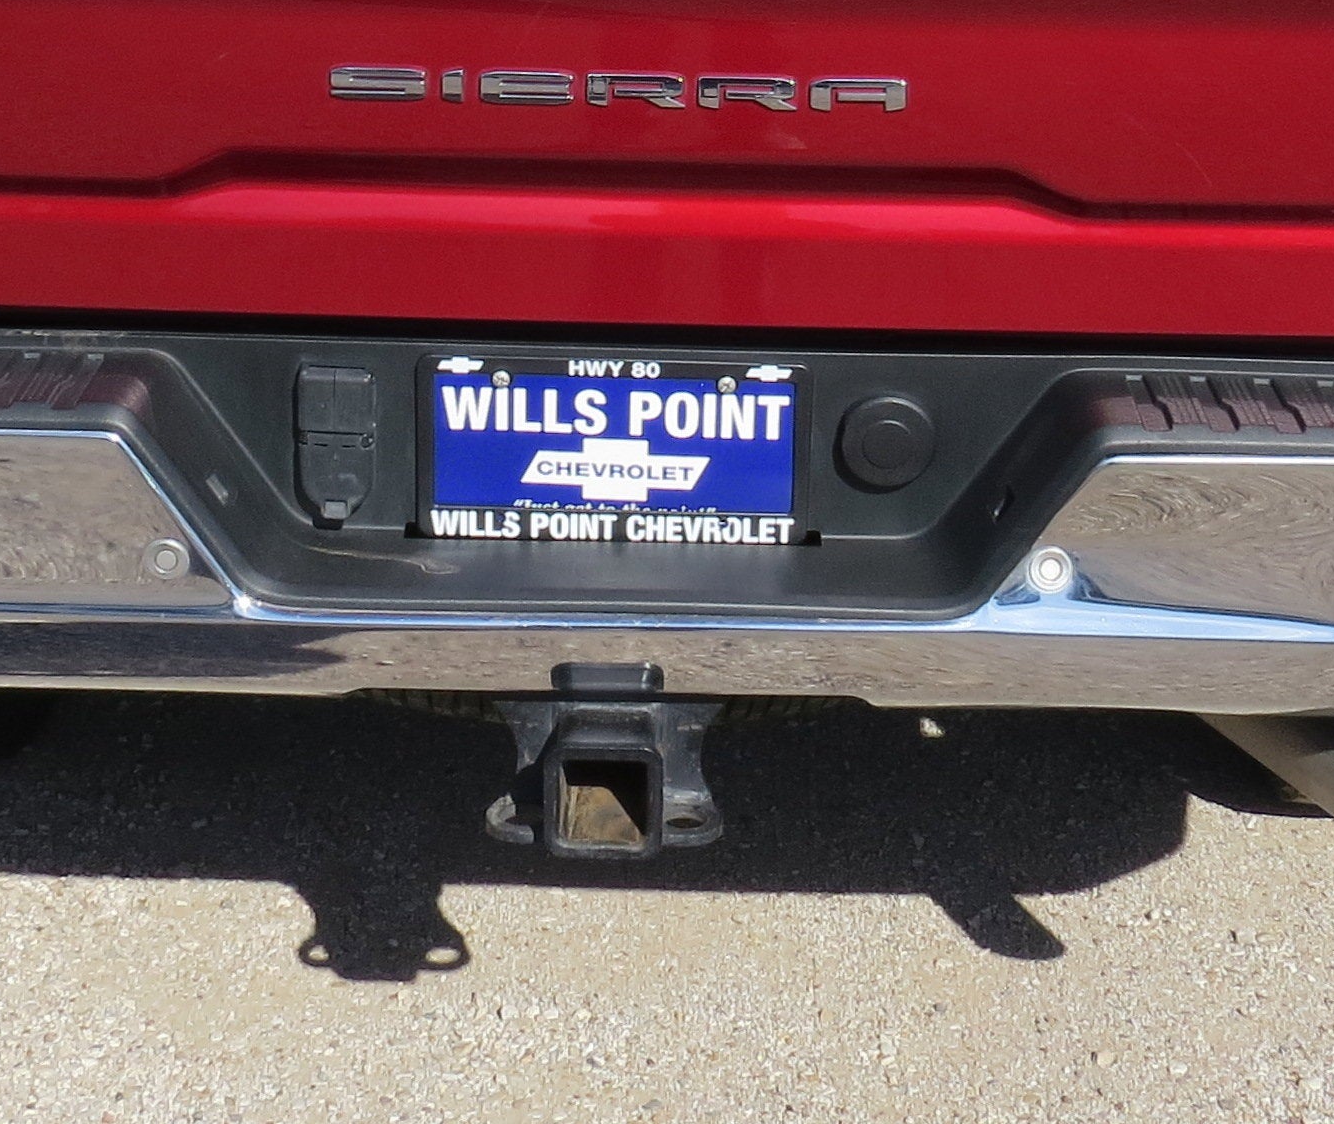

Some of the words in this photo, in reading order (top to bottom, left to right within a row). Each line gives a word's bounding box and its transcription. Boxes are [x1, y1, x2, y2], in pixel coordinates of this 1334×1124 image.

[328, 65, 909, 113] SIERRA
[568, 359, 626, 378] HWY
[630, 361, 661, 379] 80
[441, 384, 608, 435] WILLS
[628, 389, 791, 441] POINT
[536, 458, 694, 482] CHEVROLET
[430, 509, 521, 539] WILLS
[530, 511, 618, 541] POINT
[626, 514, 795, 544] CHEVROLET
